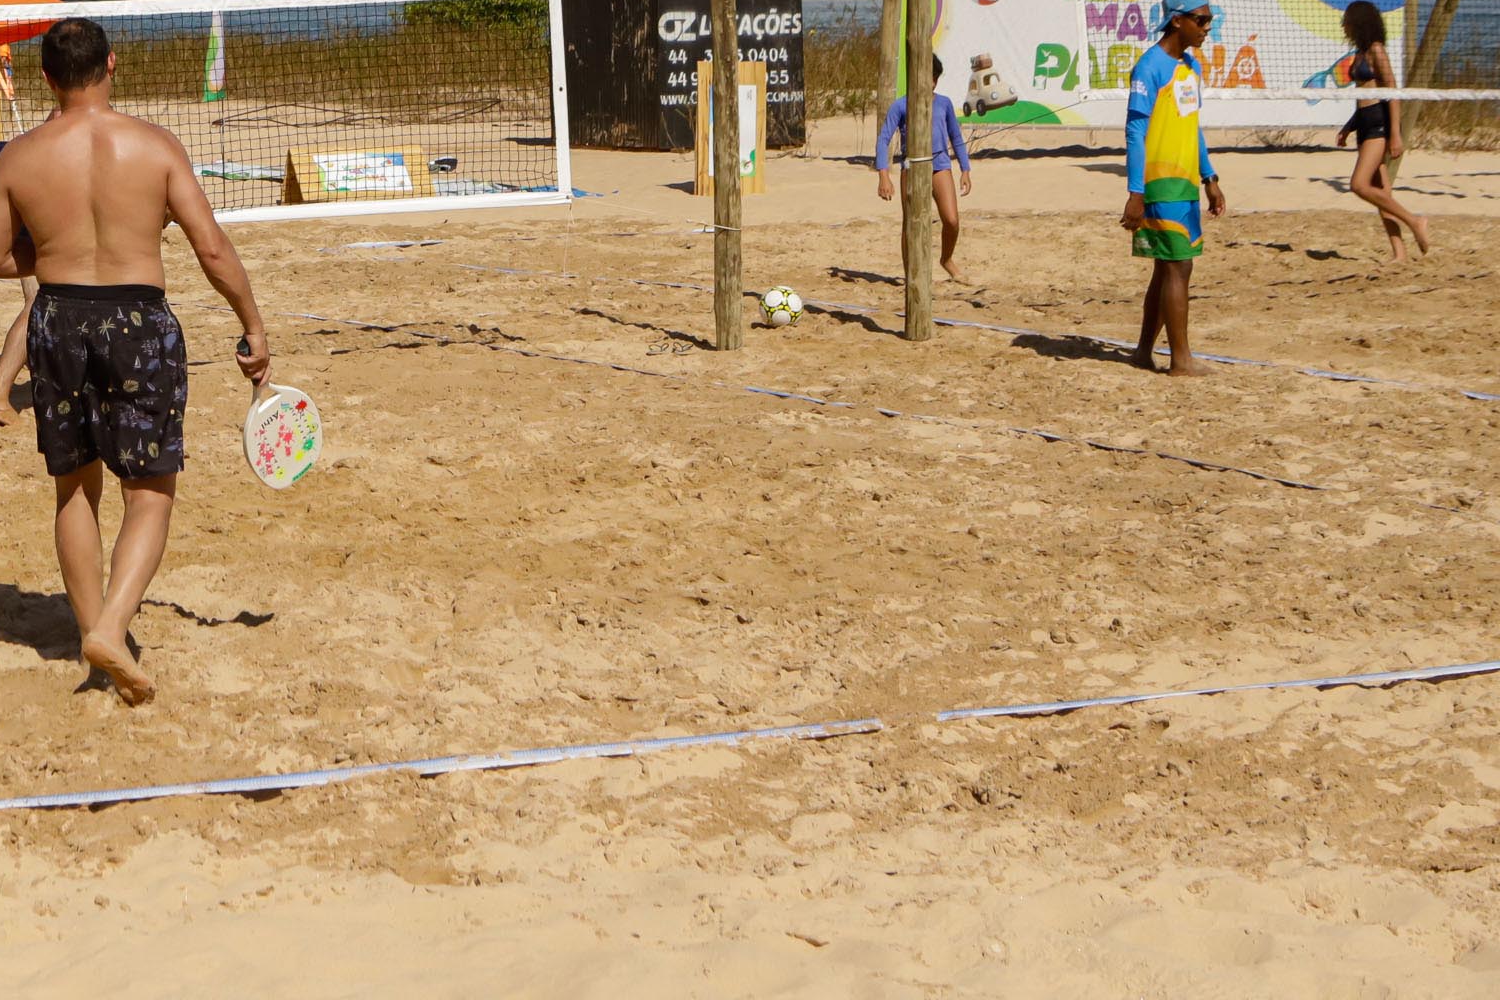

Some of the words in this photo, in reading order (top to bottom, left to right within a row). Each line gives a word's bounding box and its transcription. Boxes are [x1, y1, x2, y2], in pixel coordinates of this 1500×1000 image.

[699, 8, 802, 40] LAÇÕES
[668, 49, 688, 64] 44
[1033, 33, 1267, 91] PARNÁ
